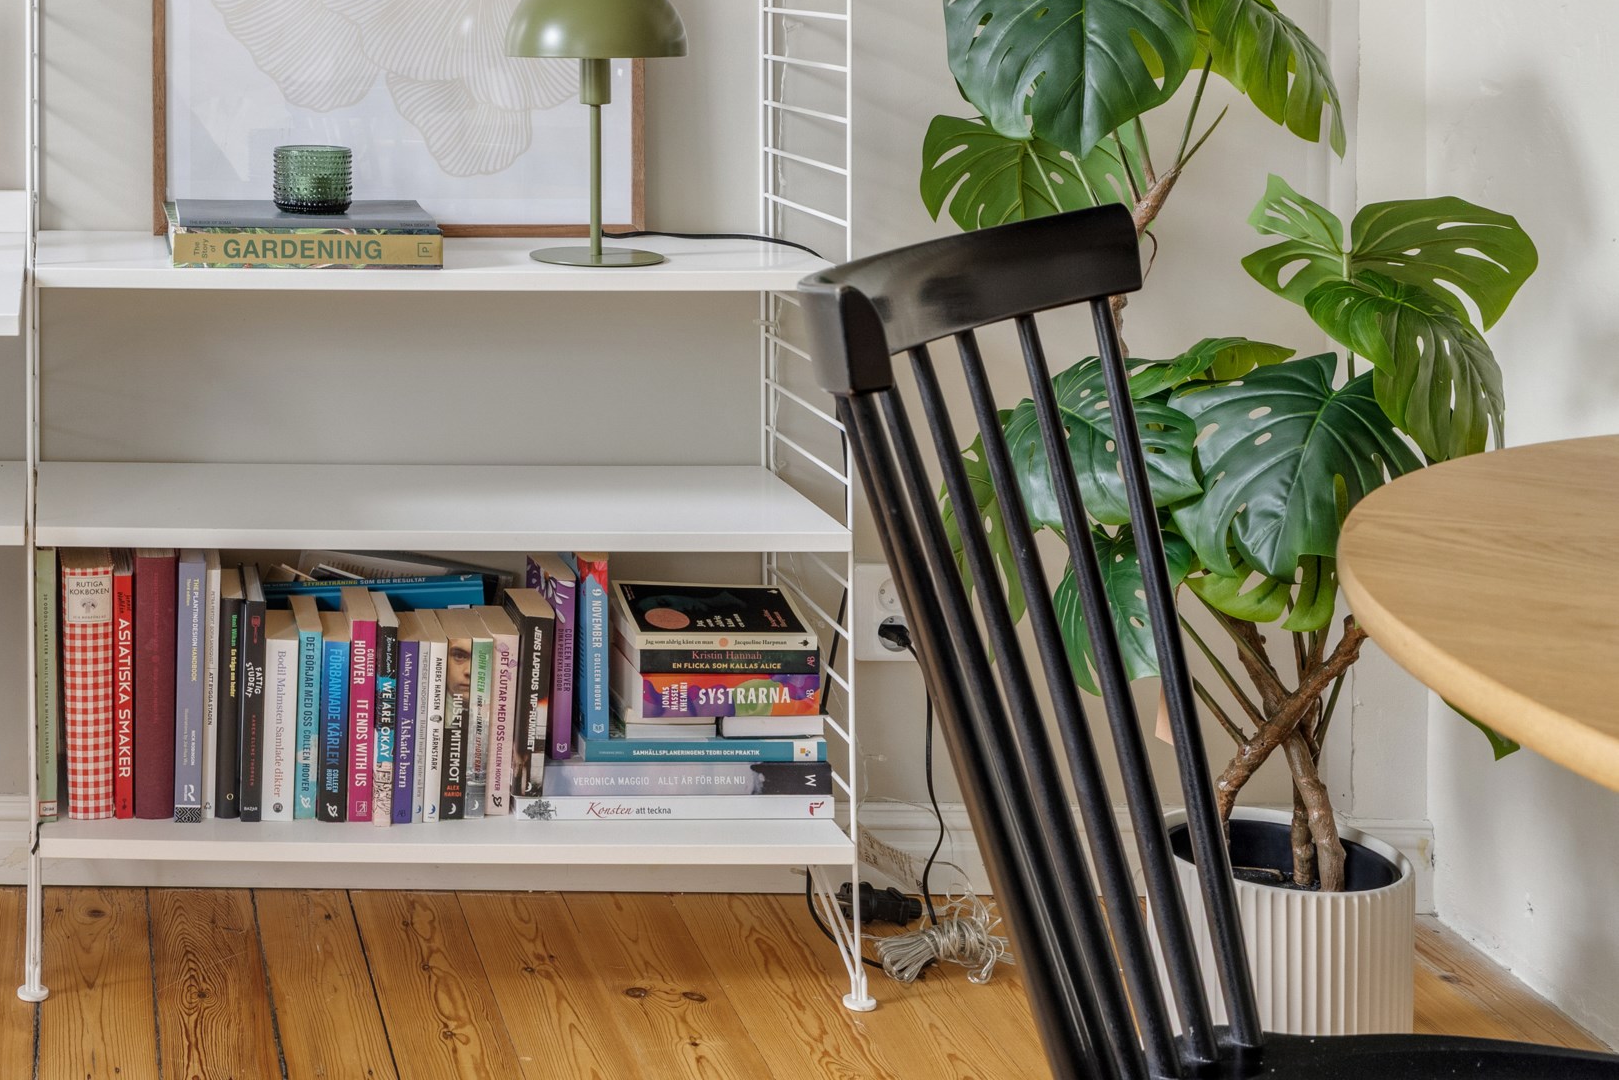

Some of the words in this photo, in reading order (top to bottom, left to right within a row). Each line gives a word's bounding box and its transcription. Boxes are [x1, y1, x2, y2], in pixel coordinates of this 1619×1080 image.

[201, 238, 209, 259] Story
[210, 244, 216, 253] of
[223, 238, 382, 260] GARDENING
[392, 576, 426, 584] RESULTAT
[591, 588, 602, 597] 9
[591, 600, 603, 649] NOVEMBER
[305, 636, 315, 653] DET
[533, 626, 543, 651] JENS
[564, 628, 573, 662] COLLEEN
[118, 618, 131, 704] ASIATISKA
[277, 650, 287, 676] Bodil
[353, 640, 366, 685] HOOVER
[366, 648, 374, 677] COLLEEN
[401, 651, 413, 677] Ashley
[478, 650, 487, 671] JOHN
[500, 651, 509, 667] DET
[692, 651, 723, 660] Kristin
[725, 651, 762, 660] Hannah
[245, 661, 255, 698] STUDENT
[254, 666, 262, 695] FATTIG
[304, 654, 316, 688] BÖRJAR
[434, 657, 442, 683] ANDERS
[477, 672, 486, 693] GREEN
[530, 651, 541, 691] LAPIDUS
[563, 662, 572, 692] HOOVER
[327, 648, 345, 720] FÖRBANNADE
[382, 681, 392, 699] WE
[402, 679, 412, 711] Audrain
[498, 669, 509, 702] SLUTAR
[662, 686, 670, 708] JONAS
[671, 684, 679, 710] HASSEN
[680, 682, 688, 712] KHEMIRI
[698, 686, 791, 705] SYSTRARNA
[275, 678, 286, 725] Malmsten
[303, 689, 314, 709] MED
[356, 699, 369, 710] IT
[433, 684, 442, 711] HANSEN
[451, 693, 464, 728] HUSET
[594, 684, 602, 711] HOOVER
[303, 710, 313, 727] OSS
[381, 701, 392, 723] ARE
[497, 704, 507, 723] MED
[526, 693, 539, 752] VIP-RUMMET
[356, 712, 368, 740] ENDS
[399, 717, 414, 760] Älskade
[496, 724, 505, 741] OSS
[118, 709, 131, 778] SMAKER
[274, 726, 285, 767] Samlade
[302, 729, 311, 761] COLLEEN
[326, 722, 342, 766] KÄRLEK
[380, 726, 391, 758] OKAY
[430, 728, 440, 771] HJÄRNSTARK
[495, 742, 503, 767] COLLEEN
[355, 742, 368, 770] WITH
[448, 729, 461, 783] MITTEMOT
[273, 767, 283, 798] dikter
[301, 763, 310, 792] HOOVER
[325, 768, 333, 791] HOOVER
[354, 773, 367, 787] US
[398, 762, 411, 788] barn
[494, 767, 502, 791] HOOVER
[573, 777, 616, 785] VERONICA
[617, 776, 650, 785] MAGGIO
[657, 776, 679, 785] ALLT
[681, 774, 693, 785] ÄR
[695, 774, 712, 785] FÖR
[714, 776, 732, 785] BRA
[734, 776, 746, 785] NU
[586, 801, 634, 818] Konsten
[635, 807, 646, 815] att
[647, 806, 672, 815] teckna
